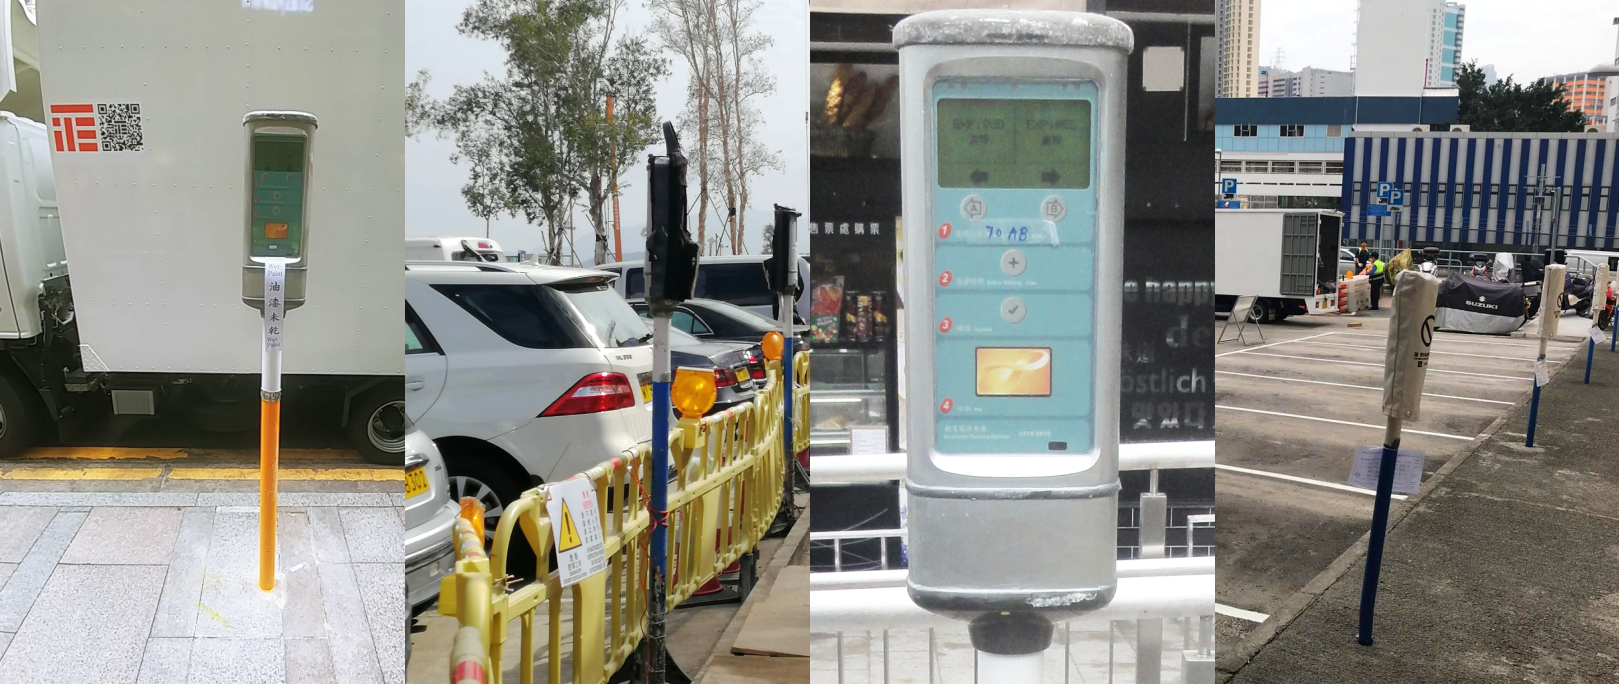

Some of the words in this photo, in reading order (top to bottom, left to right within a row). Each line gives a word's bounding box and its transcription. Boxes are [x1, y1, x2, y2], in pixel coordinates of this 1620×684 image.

[1224, 179, 1235, 192] P
[1379, 183, 1391, 196] P
[1390, 190, 1402, 204] P
[969, 203, 978, 213] A
[1050, 203, 1058, 213] B
[985, 225, 1002, 240] 70
[1007, 226, 1029, 242] AB
[941, 273, 949, 283] 2
[268, 281, 281, 335] 油漆未乾
[1465, 300, 1499, 310] SUZUKI
[941, 319, 949, 330] 3
[942, 400, 950, 410] 4
